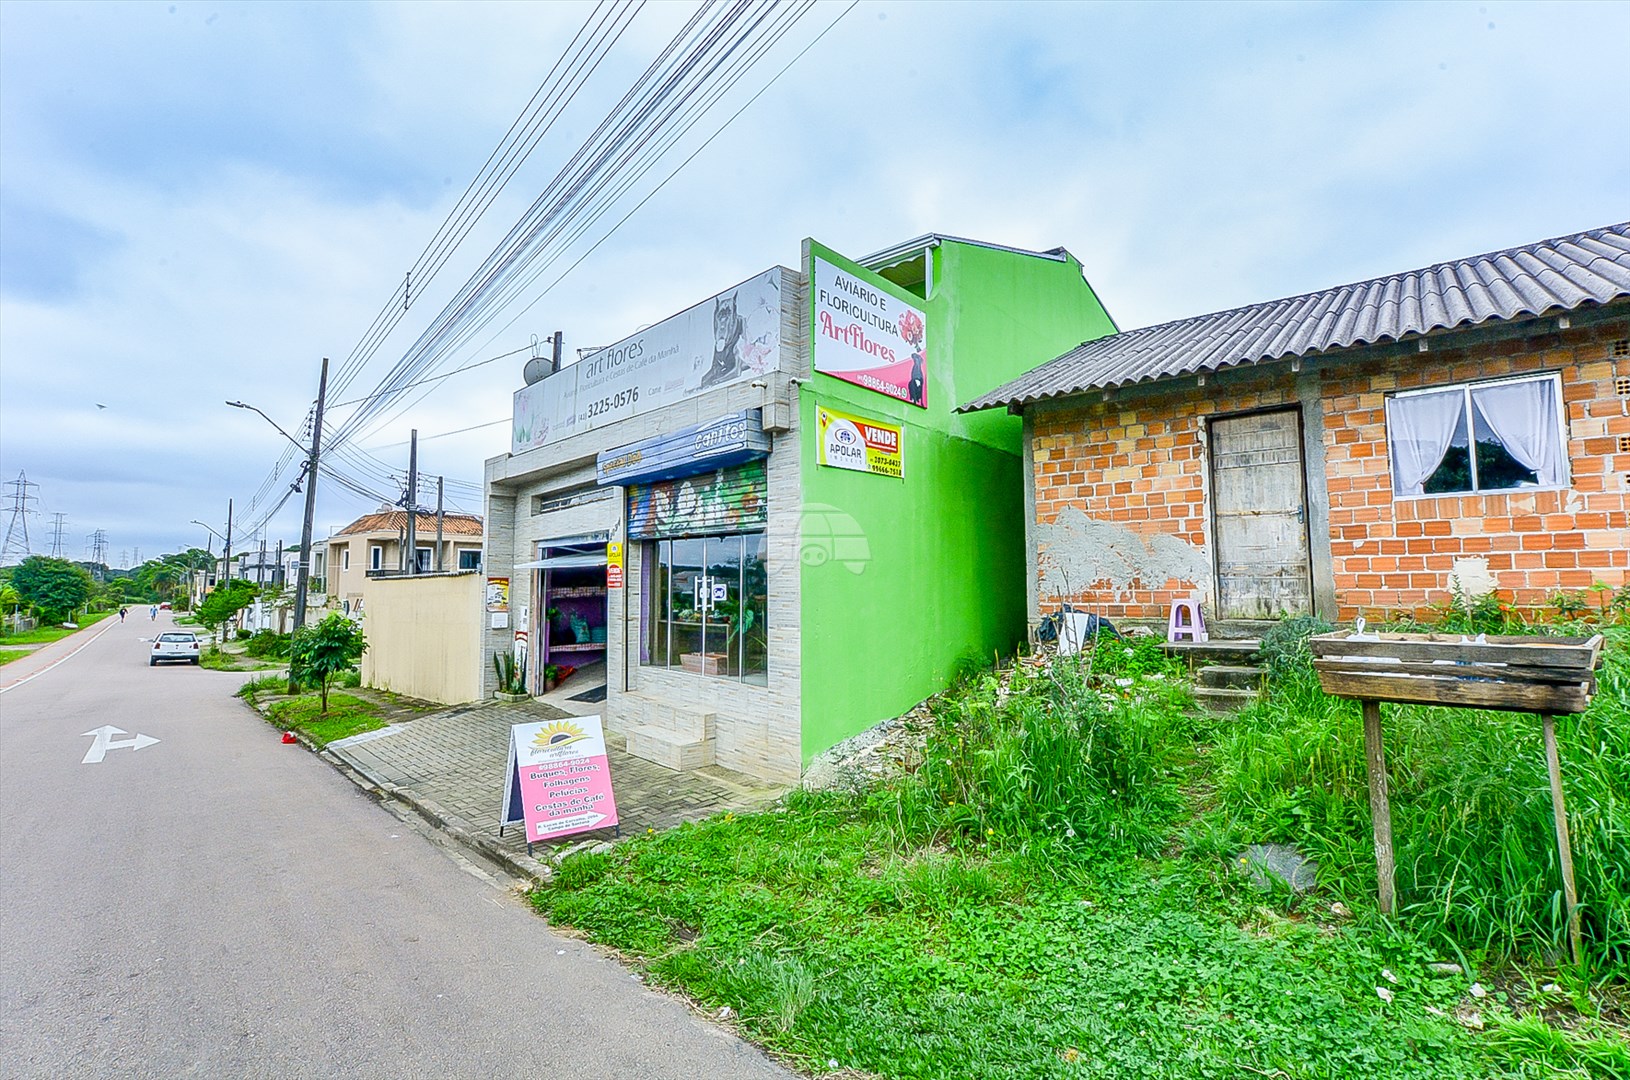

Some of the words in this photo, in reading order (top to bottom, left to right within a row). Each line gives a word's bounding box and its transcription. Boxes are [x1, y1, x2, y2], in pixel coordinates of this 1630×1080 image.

[834, 275, 878, 306] AVIÁRIO
[880, 299, 886, 311] E
[820, 290, 898, 337] FLORICULTURA
[586, 358, 604, 378] art
[607, 339, 644, 370] flores
[626, 364, 633, 373] de
[648, 354, 656, 364] da
[588, 386, 639, 418] 3225-0576
[864, 426, 897, 446] VENDE
[830, 443, 862, 458] APOLAR
[544, 777, 590, 787] Folhagens
[535, 801, 567, 811] Cestas
